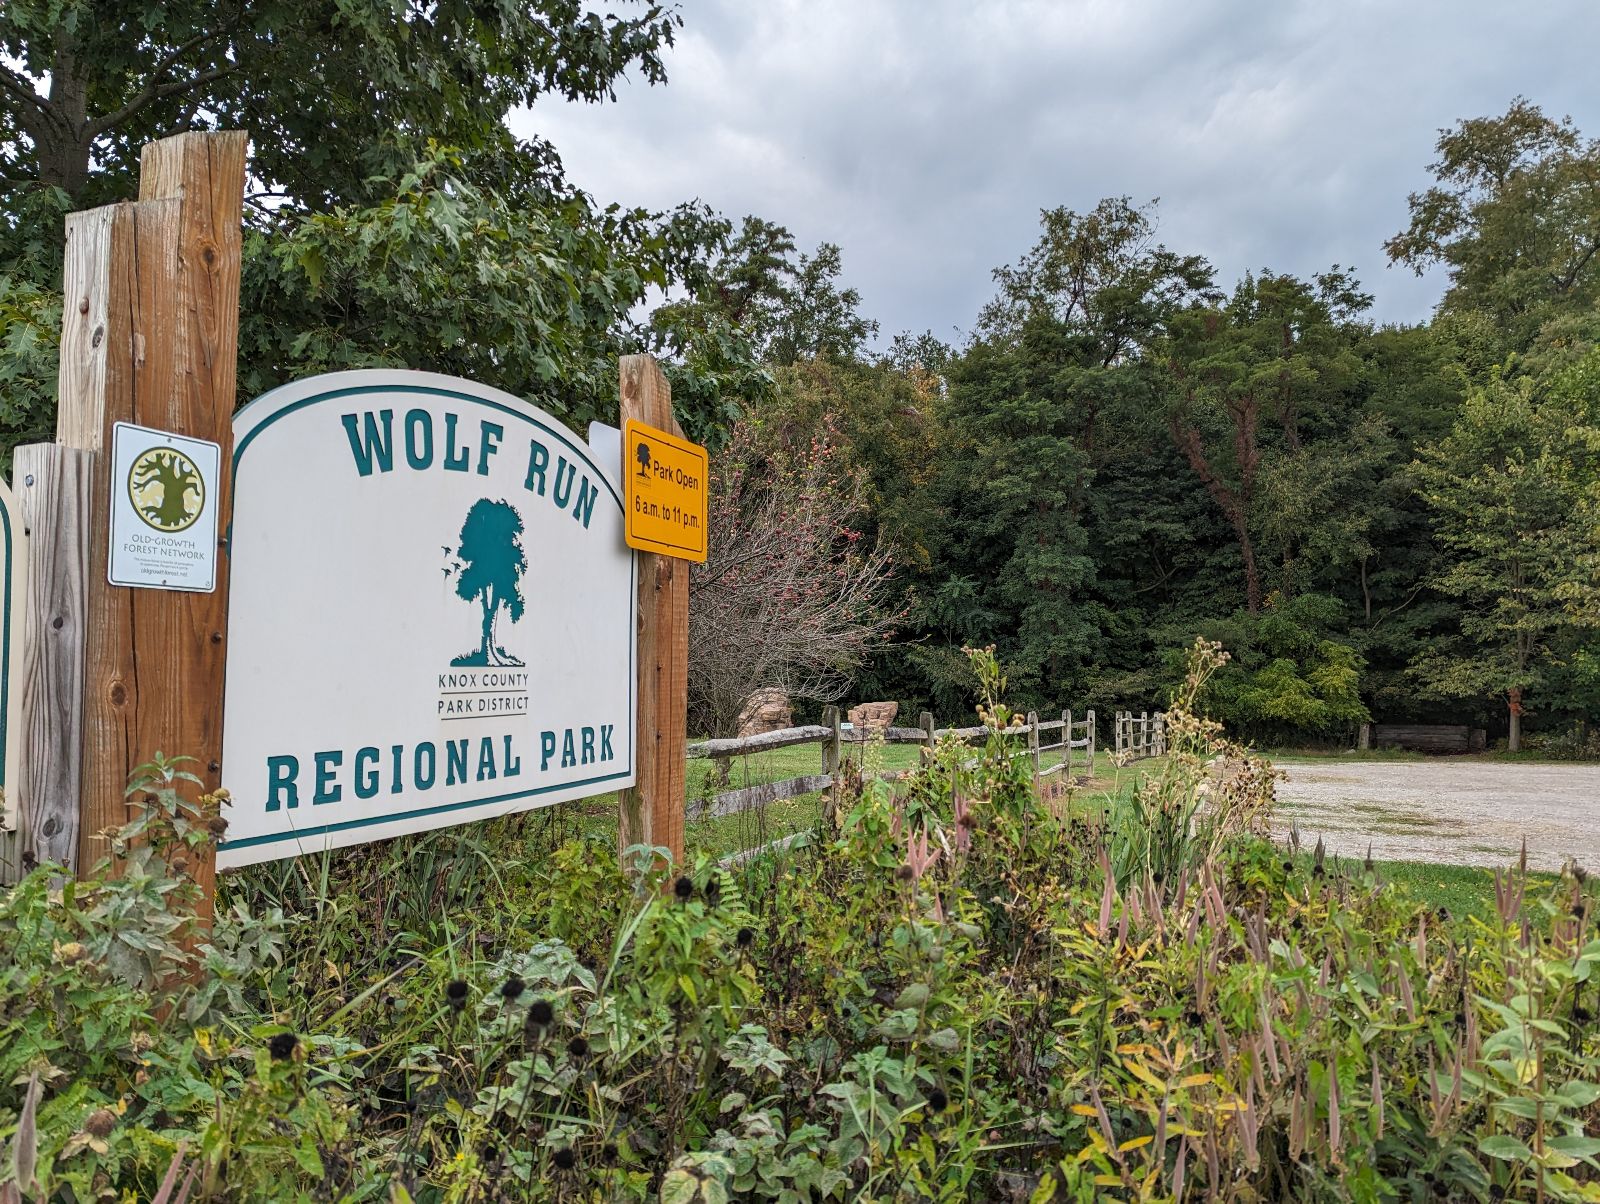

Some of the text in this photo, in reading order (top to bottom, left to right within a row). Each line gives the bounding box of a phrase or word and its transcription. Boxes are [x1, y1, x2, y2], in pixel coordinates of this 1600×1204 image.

[341, 408, 599, 530] WOLF RUN
[653, 459, 673, 482] Park
[676, 468, 699, 490] Open
[635, 494, 700, 529] 6 a.m. to 11 p.m.
[123, 543, 205, 560] FOREST NETWORK
[131, 534, 195, 549] OLD-GROWTH
[439, 673, 529, 688] KNOX COUNTY
[438, 697, 529, 714] PARK DISTRICT
[265, 724, 614, 812] REGIONAL PARK
